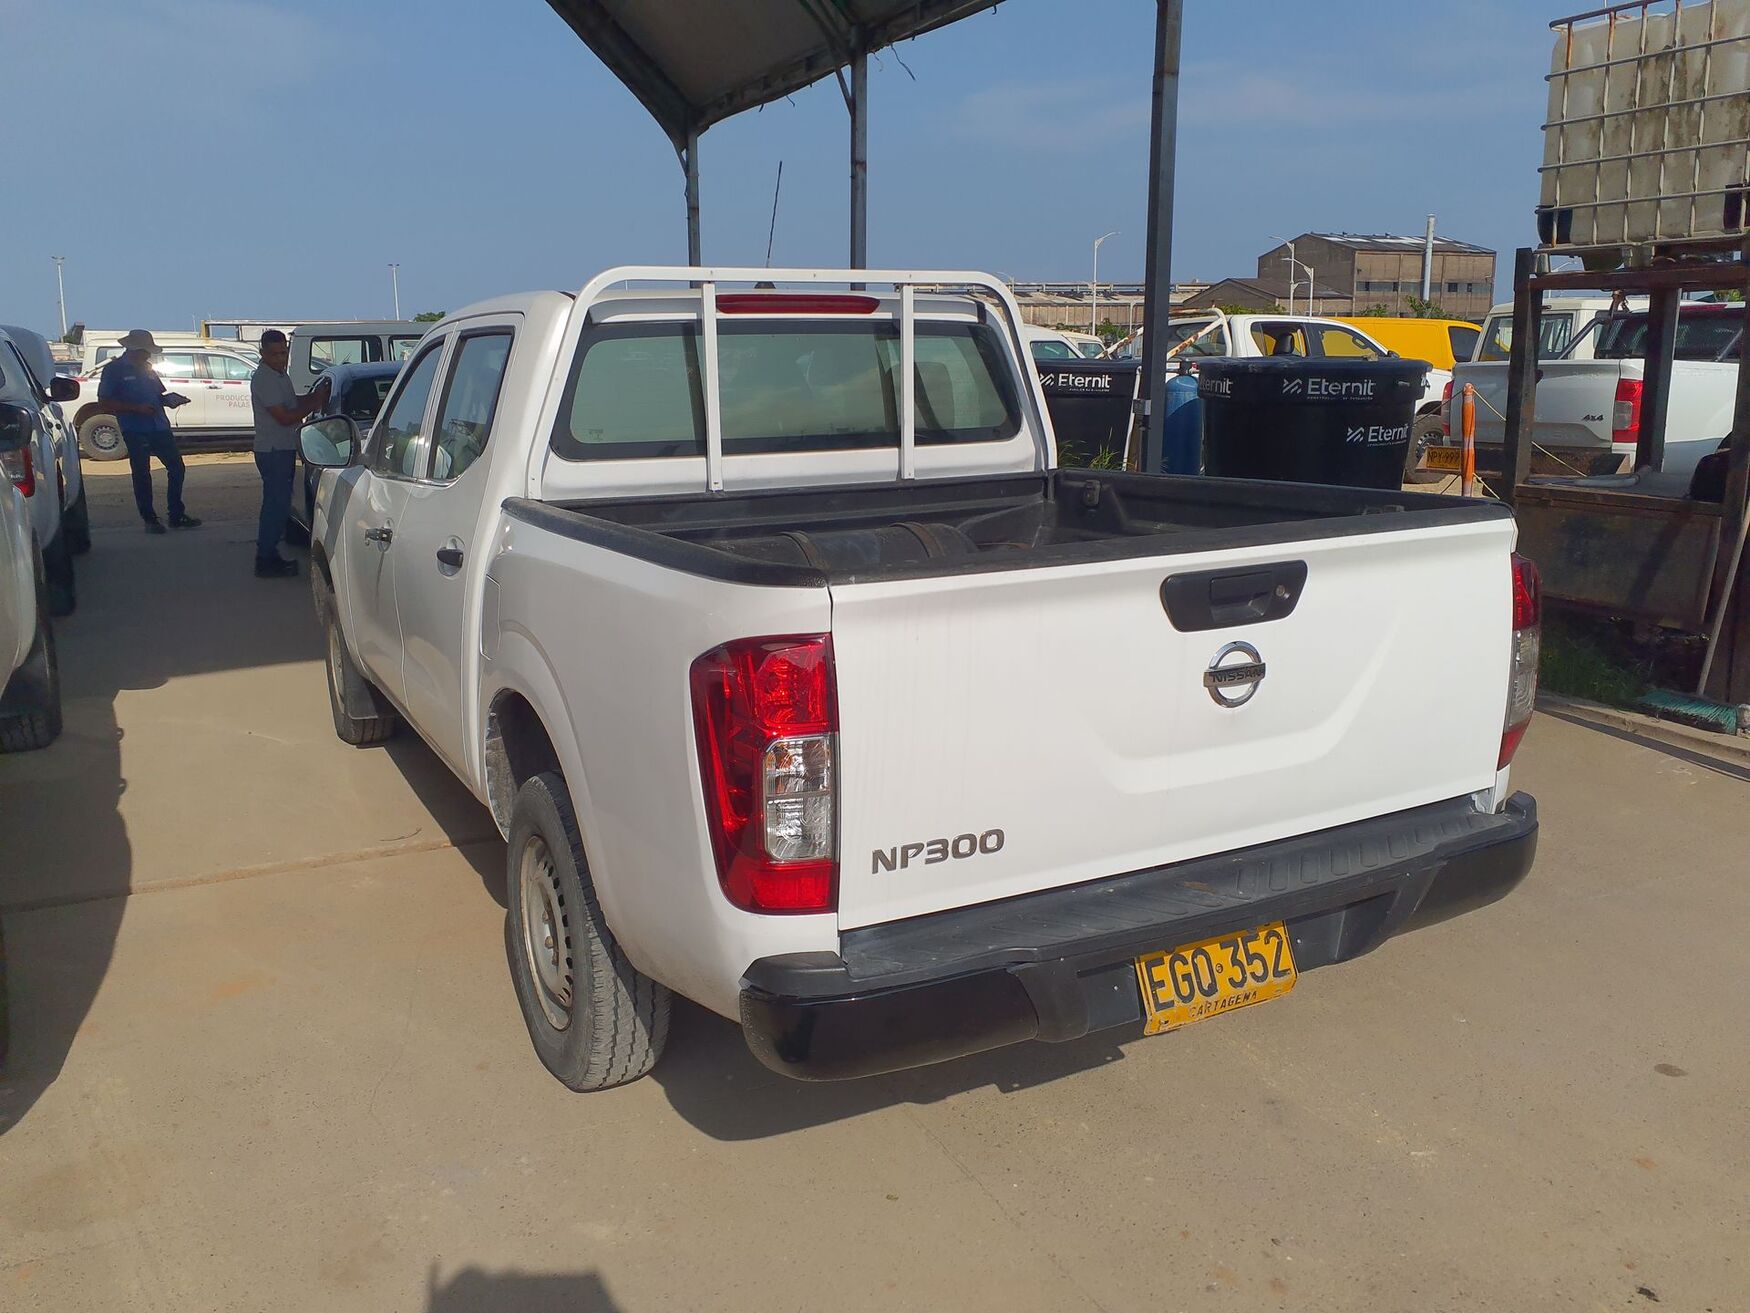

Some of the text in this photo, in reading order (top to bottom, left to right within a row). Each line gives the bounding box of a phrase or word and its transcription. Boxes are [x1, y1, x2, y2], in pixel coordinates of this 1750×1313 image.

[1058, 373, 1112, 388] Eternit
[1307, 378, 1376, 396] Eternit
[1367, 424, 1408, 442] Eternit
[1210, 668, 1262, 683] NISSAN
[871, 828, 1005, 875] NP300
[1188, 990, 1258, 1018] CARTAGENA
